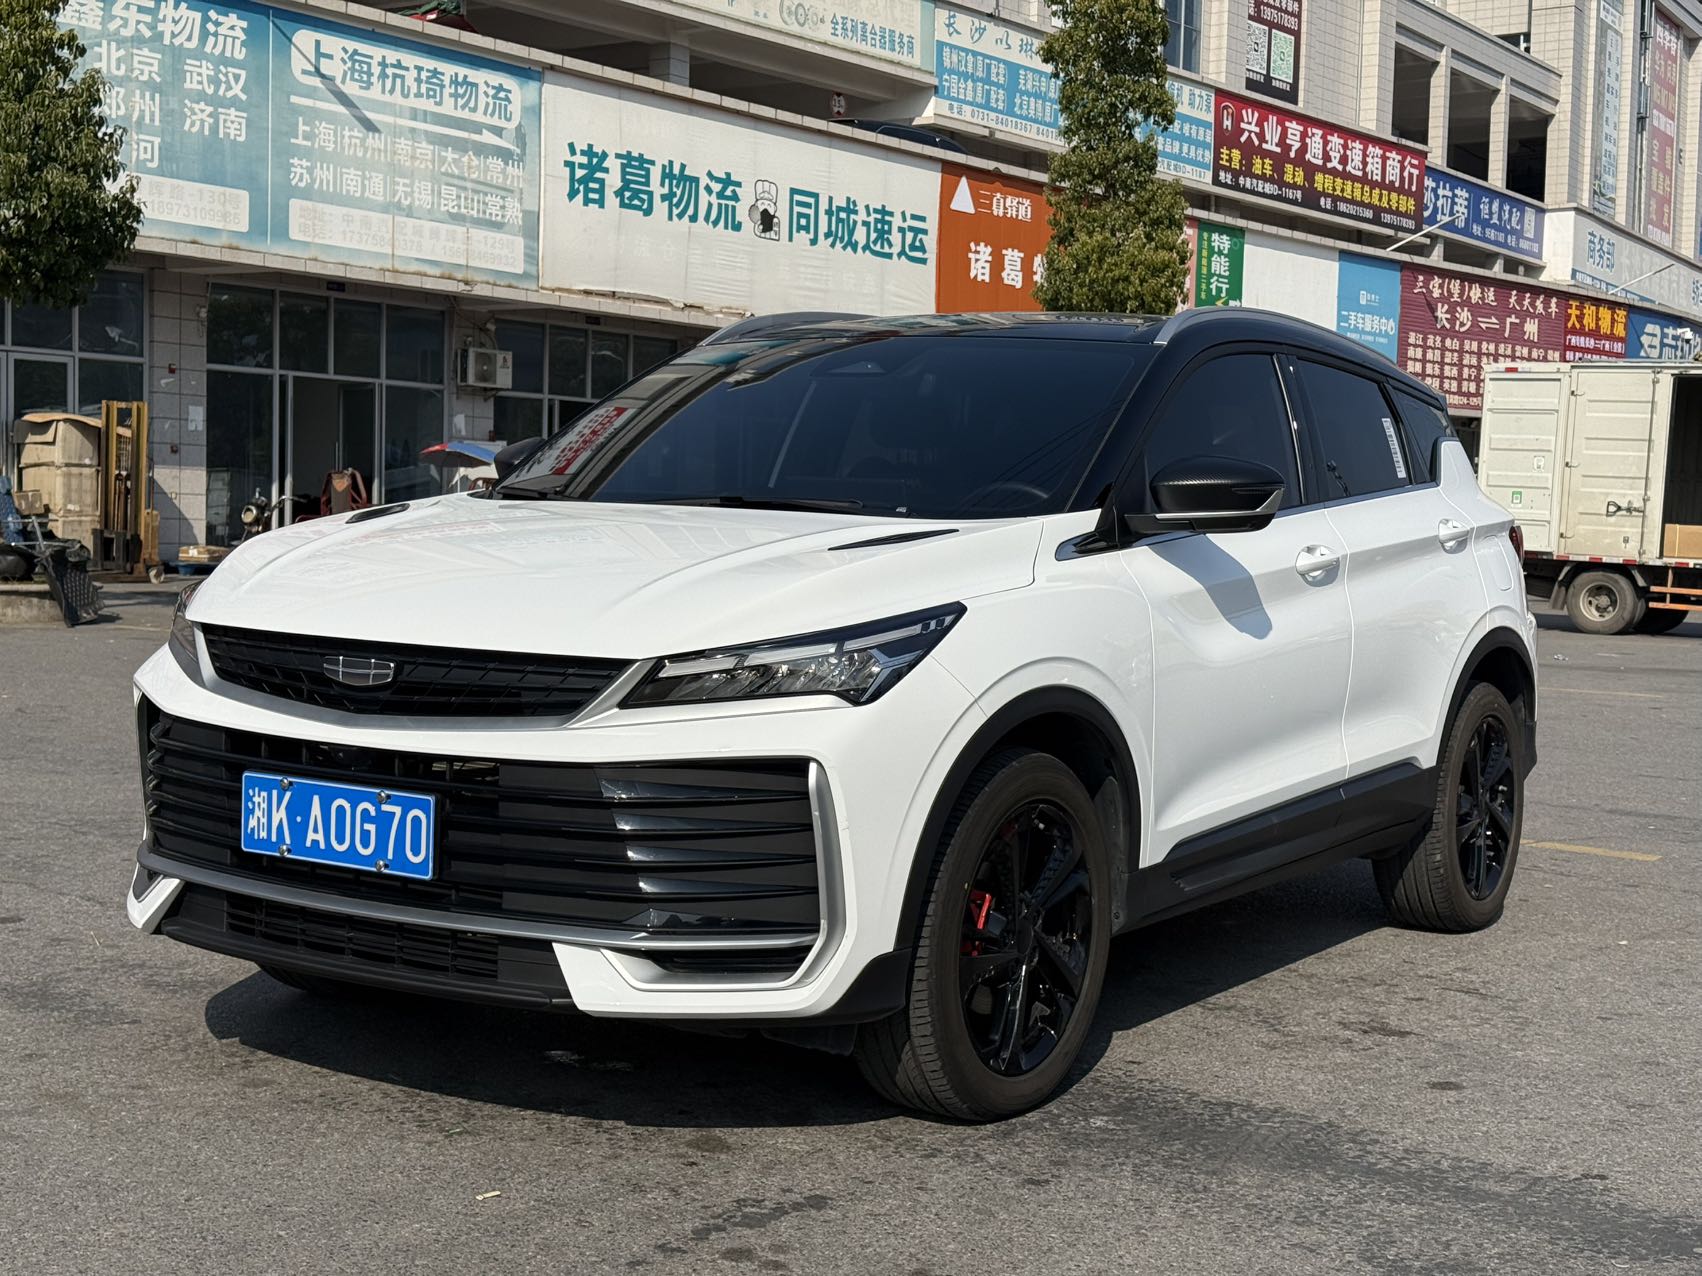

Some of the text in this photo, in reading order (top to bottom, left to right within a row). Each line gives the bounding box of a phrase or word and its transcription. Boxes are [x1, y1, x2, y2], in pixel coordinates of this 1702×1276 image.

[830, 12, 915, 59] 全系列离合器服务商
[93, 39, 248, 101] 北京 武汉
[301, 38, 513, 122] 上海杭琦物流
[183, 99, 248, 142] 济南
[1239, 108, 1420, 193] 兴业亨通变速箱商行
[563, 141, 930, 266] 诸葛物流 同城速运
[1209, 232, 1232, 298] 特能行
[1340, 310, 1396, 336] 二手车服务中心
[1434, 302, 1539, 343] 长沙 广州
[1567, 300, 1628, 337] 天和物流
